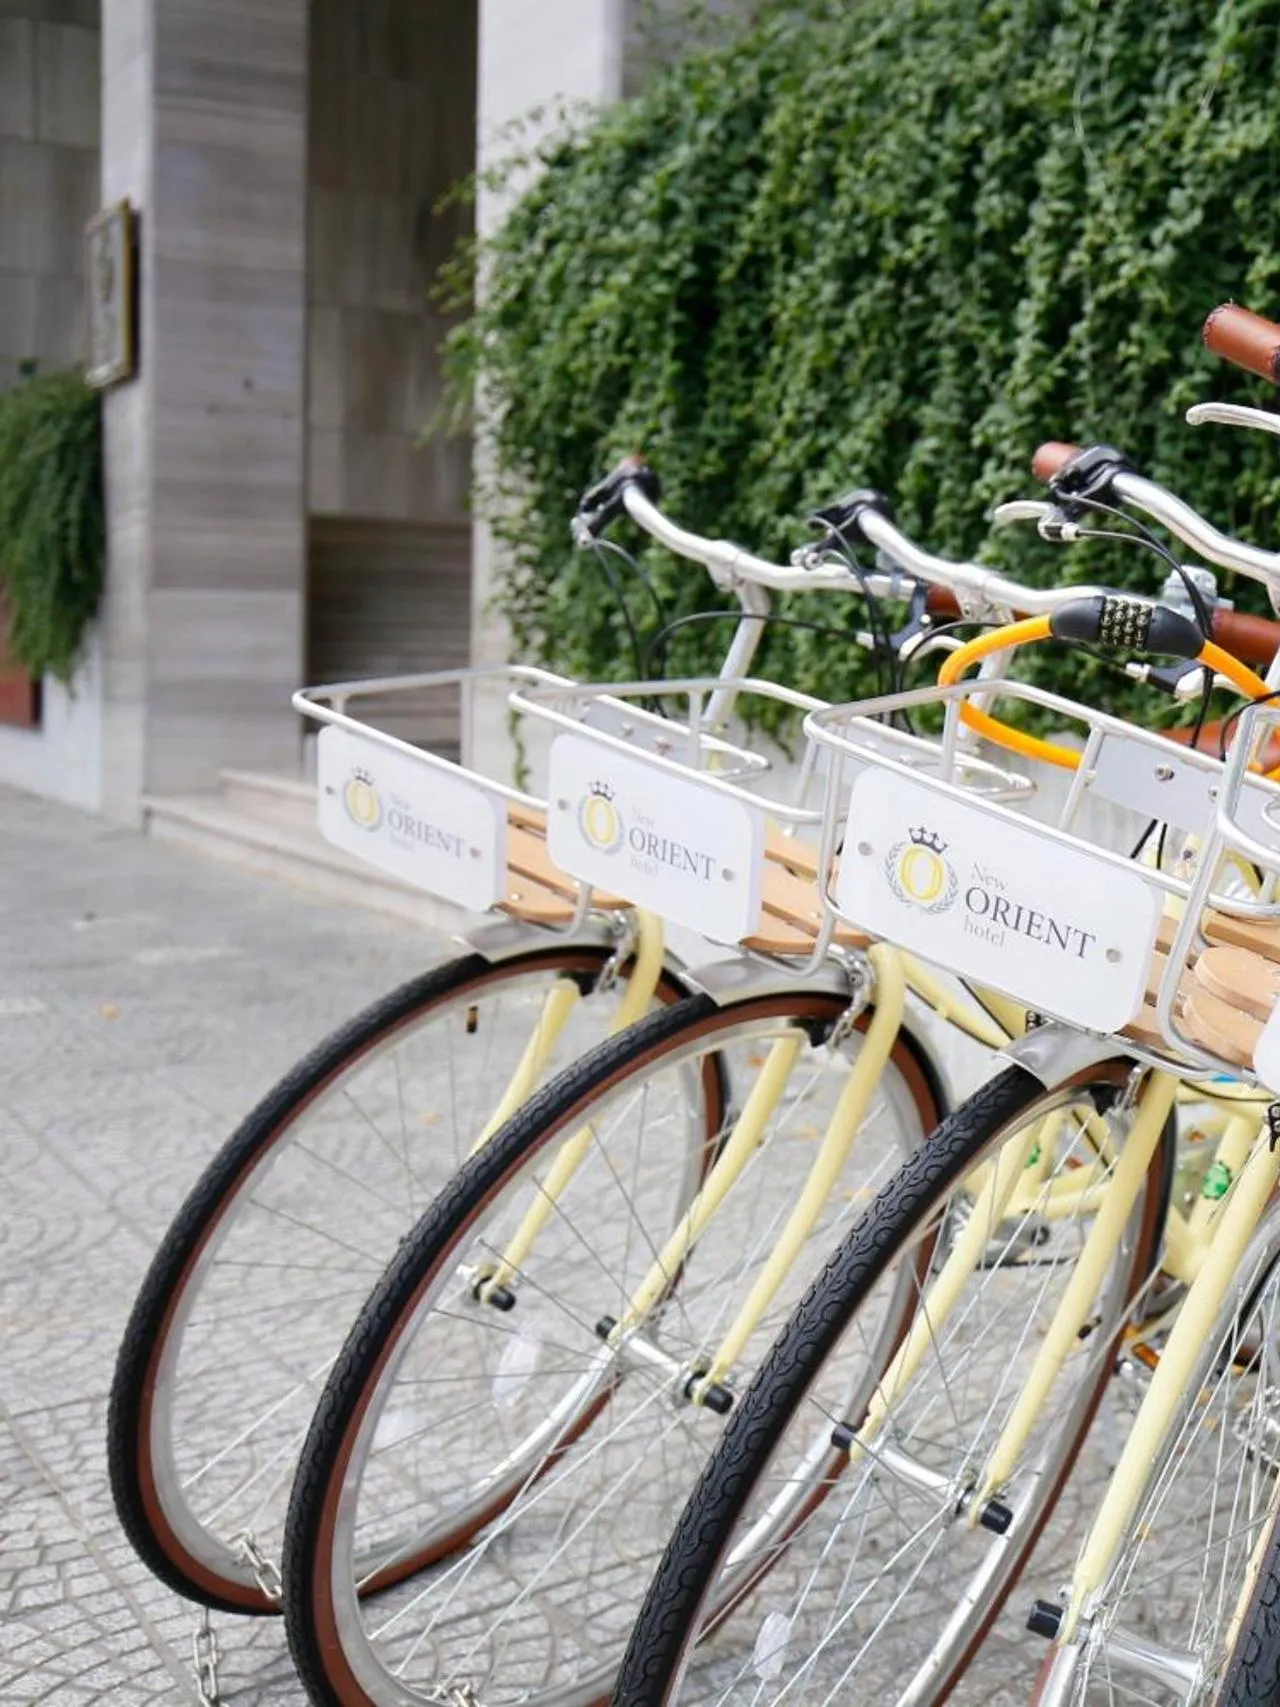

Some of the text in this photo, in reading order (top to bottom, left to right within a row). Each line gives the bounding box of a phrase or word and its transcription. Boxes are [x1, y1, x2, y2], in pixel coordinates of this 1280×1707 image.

[387, 807, 466, 858] ORIENT
[629, 826, 717, 881] ORIENT
[972, 862, 1008, 893] New
[963, 915, 1006, 948] hotel
[965, 887, 1096, 958] ORIENT
